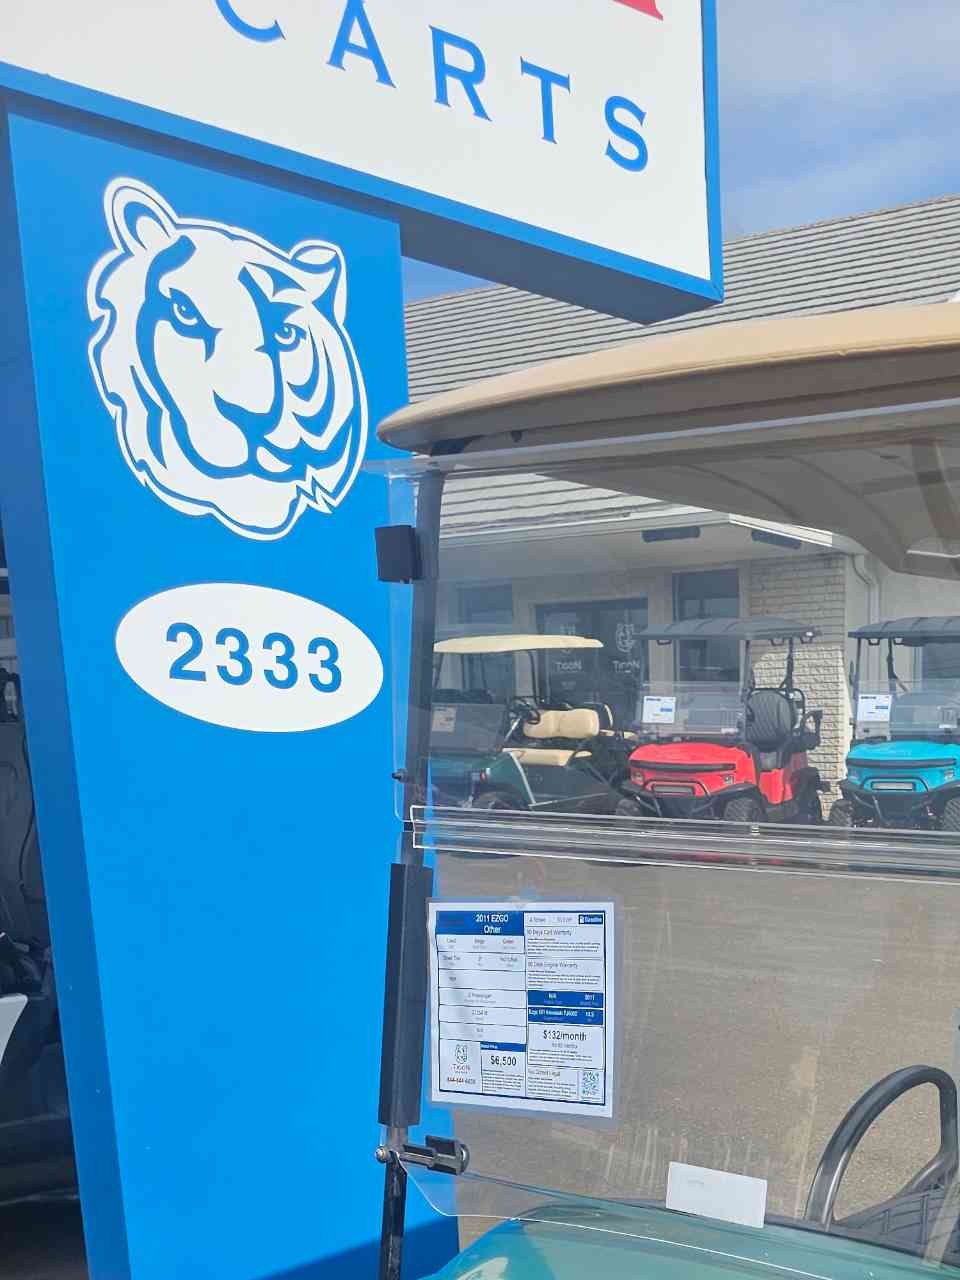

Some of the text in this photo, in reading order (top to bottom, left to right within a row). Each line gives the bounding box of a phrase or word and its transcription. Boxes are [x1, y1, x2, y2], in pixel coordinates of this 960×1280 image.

[165, 623, 343, 693] 2333
[475, 914, 509, 923] 2011 EZGO
[484, 925, 502, 934] Other
